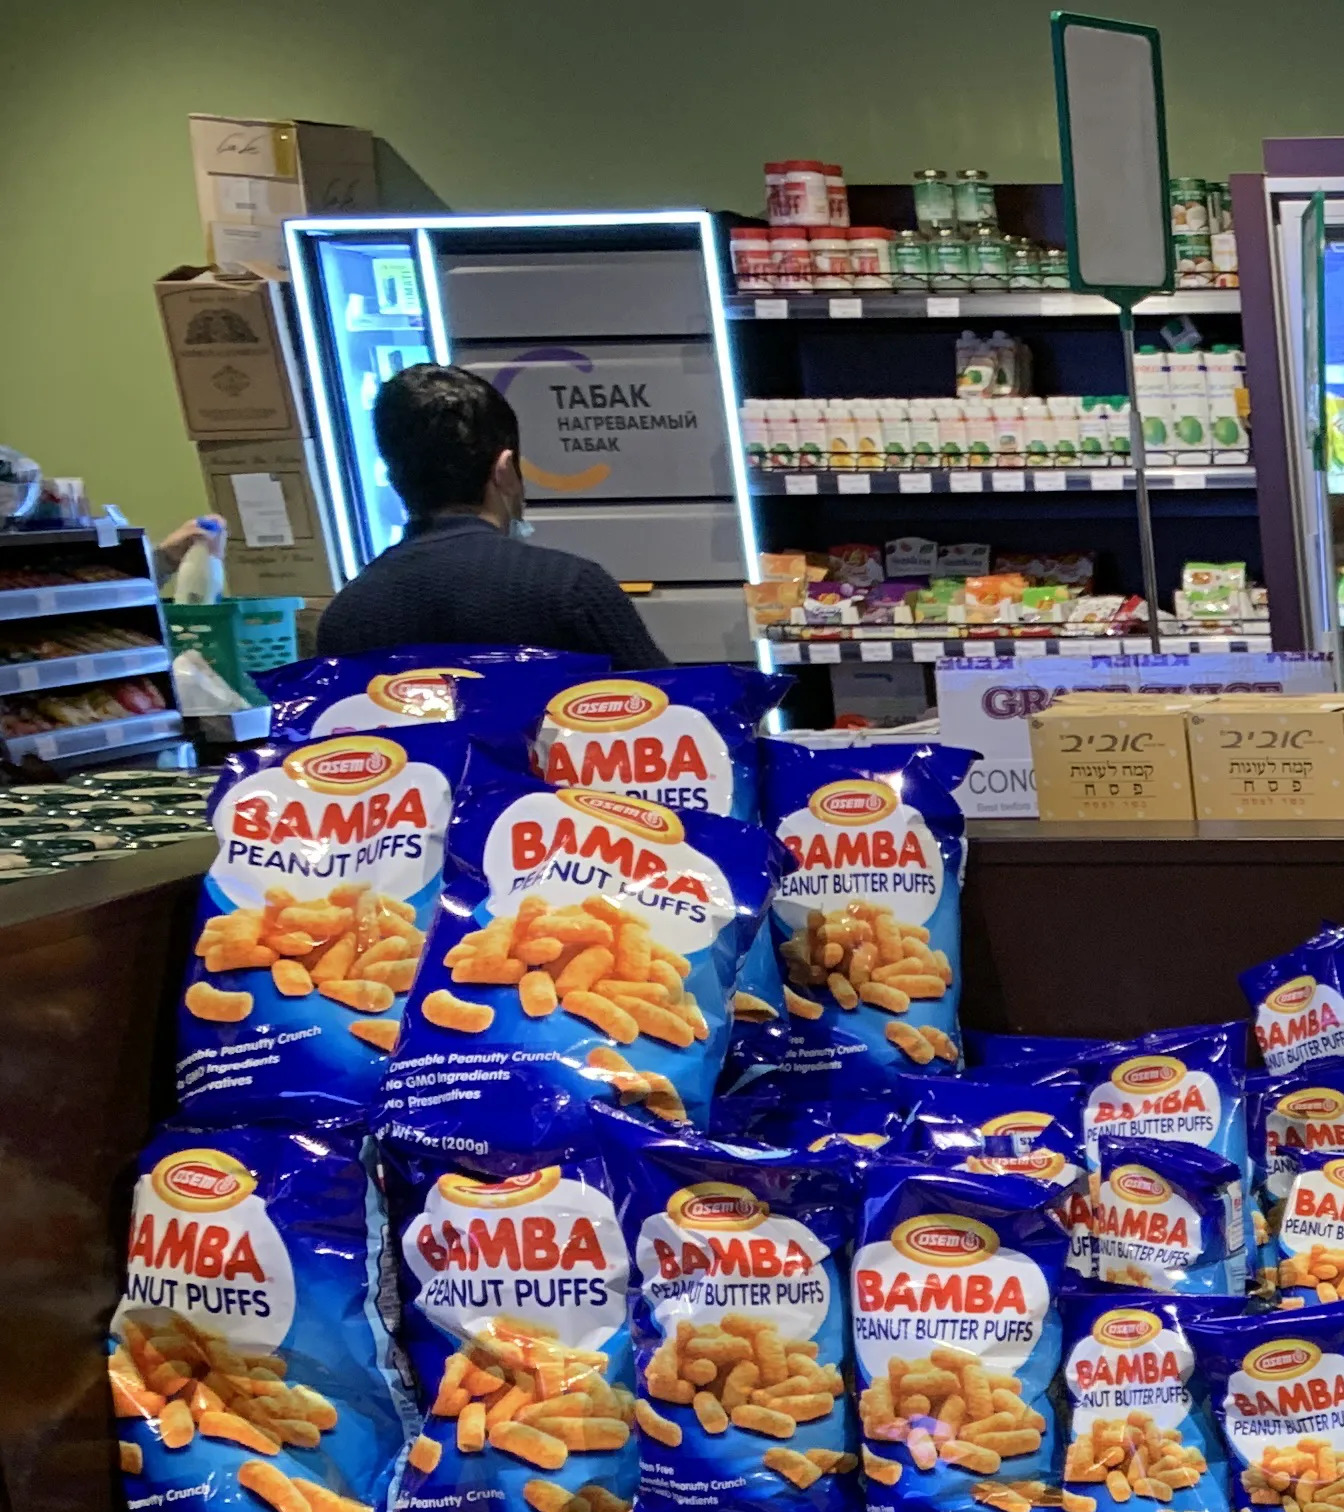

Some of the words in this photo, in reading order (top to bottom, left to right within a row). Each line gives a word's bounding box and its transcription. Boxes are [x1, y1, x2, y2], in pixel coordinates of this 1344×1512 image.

[550, 383, 652, 410] ТАБАК
[558, 410, 698, 431] НАГРЕВАЕМЫЙ
[561, 437, 620, 453] ТАБАК
[318, 757, 364, 773] OSEM
[1122, 764, 1153, 779] קמח
[1282, 761, 1313, 776] קמח
[232, 788, 428, 845] BAMBA
[228, 839, 350, 879] PEANUT
[355, 834, 422, 870] PUFFS
[511, 817, 710, 904] BAMBA
[509, 860, 614, 897] PEANUT
[618, 883, 707, 923] PUFFS
[833, 875, 889, 895] BUTTER
[893, 875, 936, 895] PUFFS
[512, 1050, 560, 1063] Crunch
[437, 1068, 510, 1084] Ingredients
[417, 1217, 608, 1272] BAMBA
[918, 1233, 961, 1247] OSEM
[654, 1238, 813, 1279] BAMBA
[425, 1279, 506, 1309] PEANUT
[515, 1278, 608, 1308] PUFFS
[856, 1270, 1029, 1314] BAMBA
[855, 1317, 912, 1342] PEANUT
[915, 1317, 981, 1342] BUTTER
[983, 1318, 1033, 1343] PUFFS
[1233, 1417, 1283, 1437] PEANUT
[1284, 1414, 1329, 1435] BUTTER
